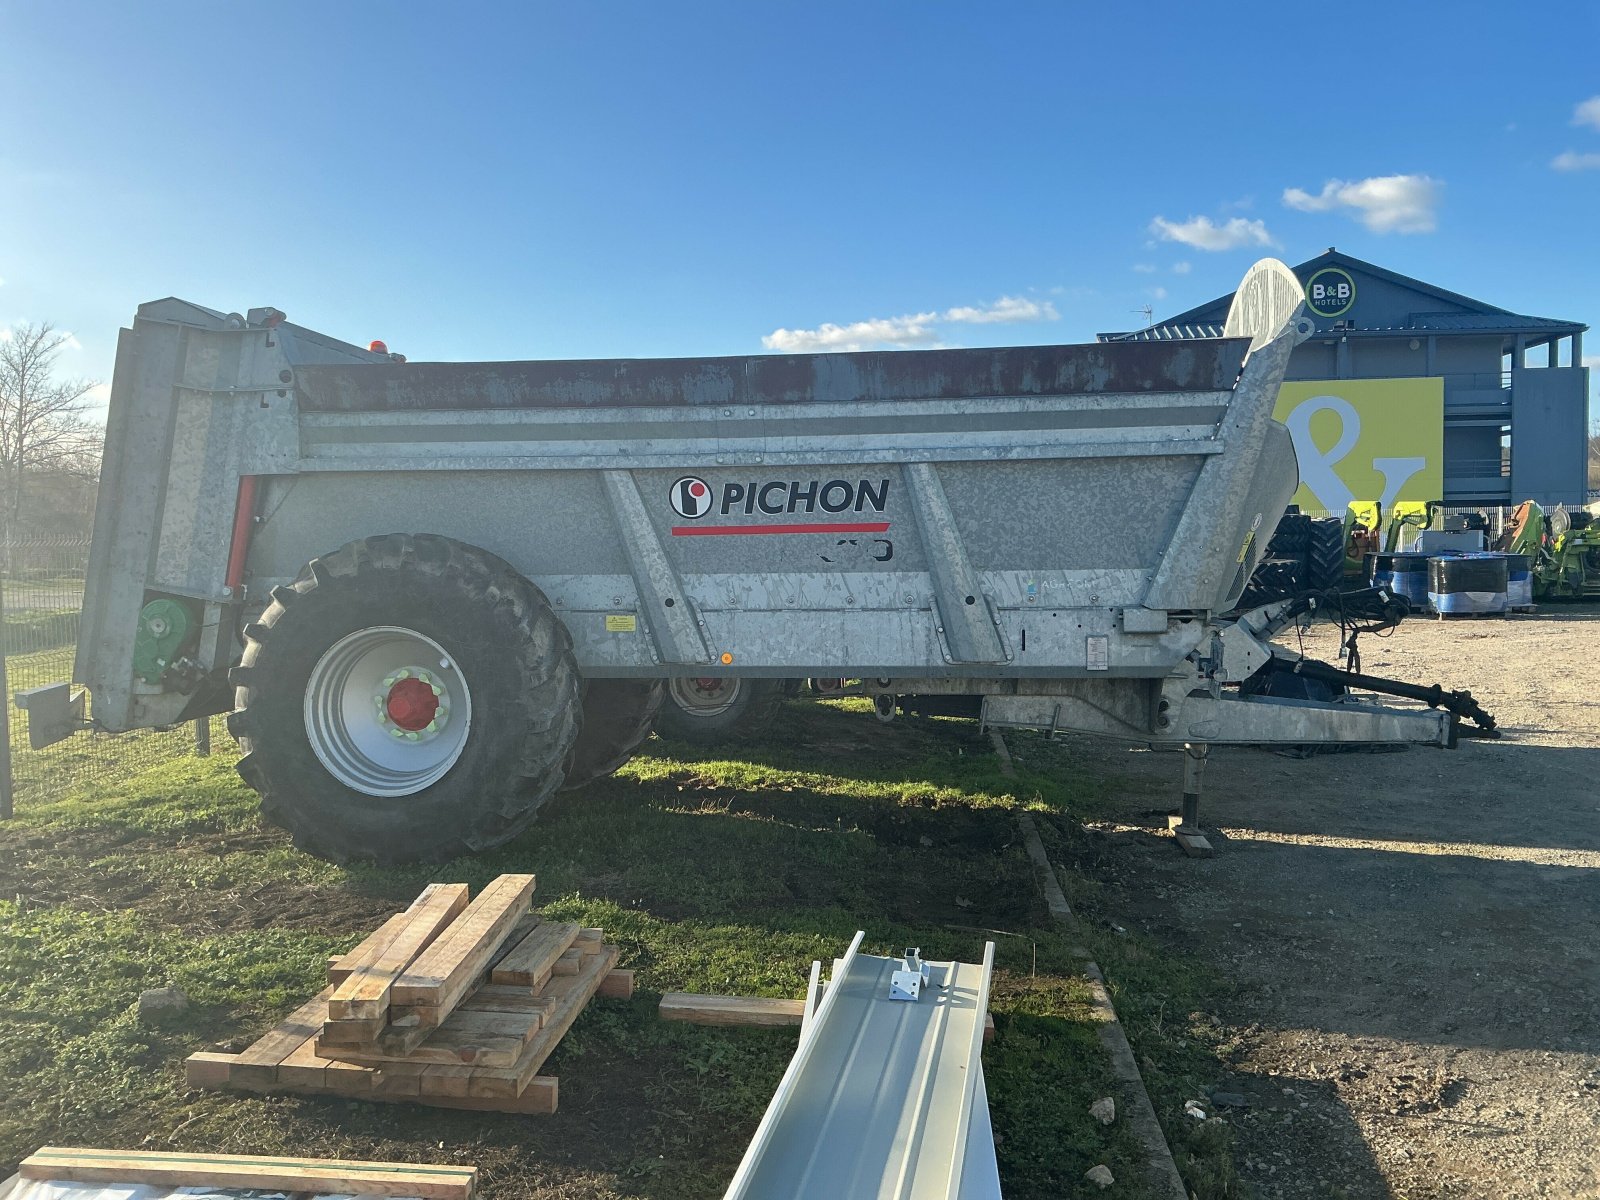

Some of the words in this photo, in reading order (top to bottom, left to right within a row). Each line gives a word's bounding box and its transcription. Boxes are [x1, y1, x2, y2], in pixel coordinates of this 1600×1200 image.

[1313, 283, 1350, 299] B&B
[1315, 298, 1347, 306] HOTELS
[719, 479, 890, 516] PICHON
